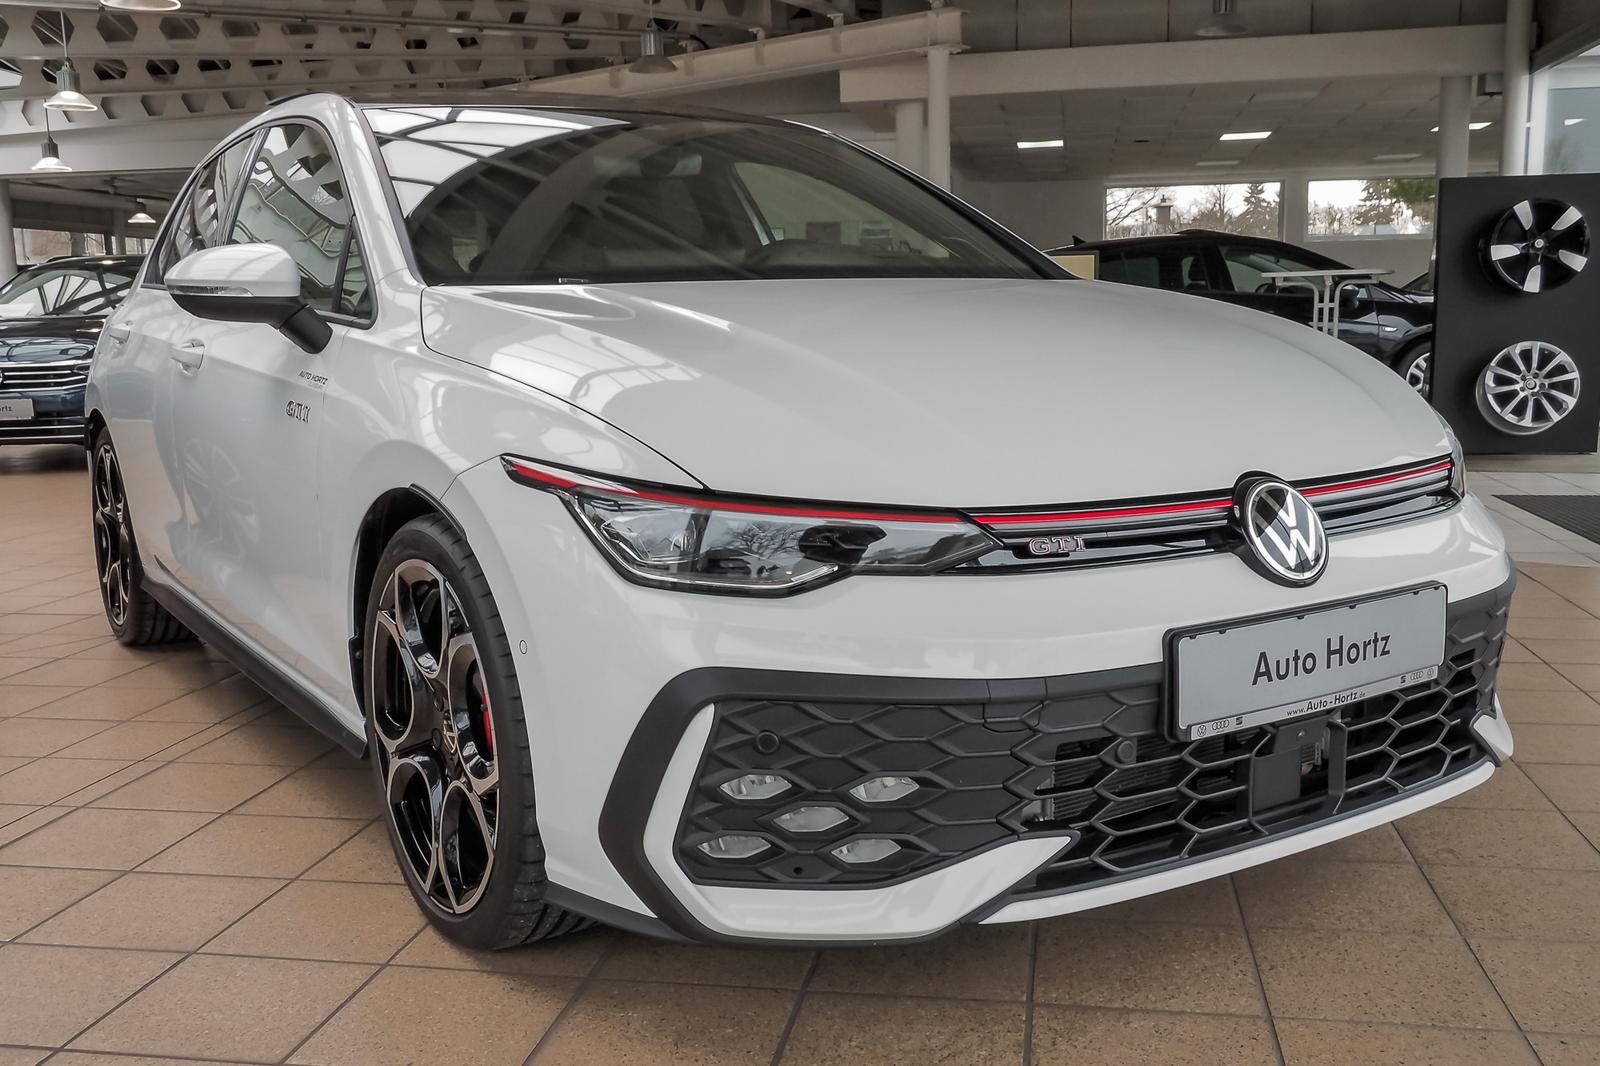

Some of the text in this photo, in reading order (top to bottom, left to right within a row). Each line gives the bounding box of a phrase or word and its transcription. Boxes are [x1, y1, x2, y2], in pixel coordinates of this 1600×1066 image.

[298, 370, 312, 380] AUTO
[1029, 535, 1086, 555] GTI
[1252, 631, 1391, 686] Auto Hortz
